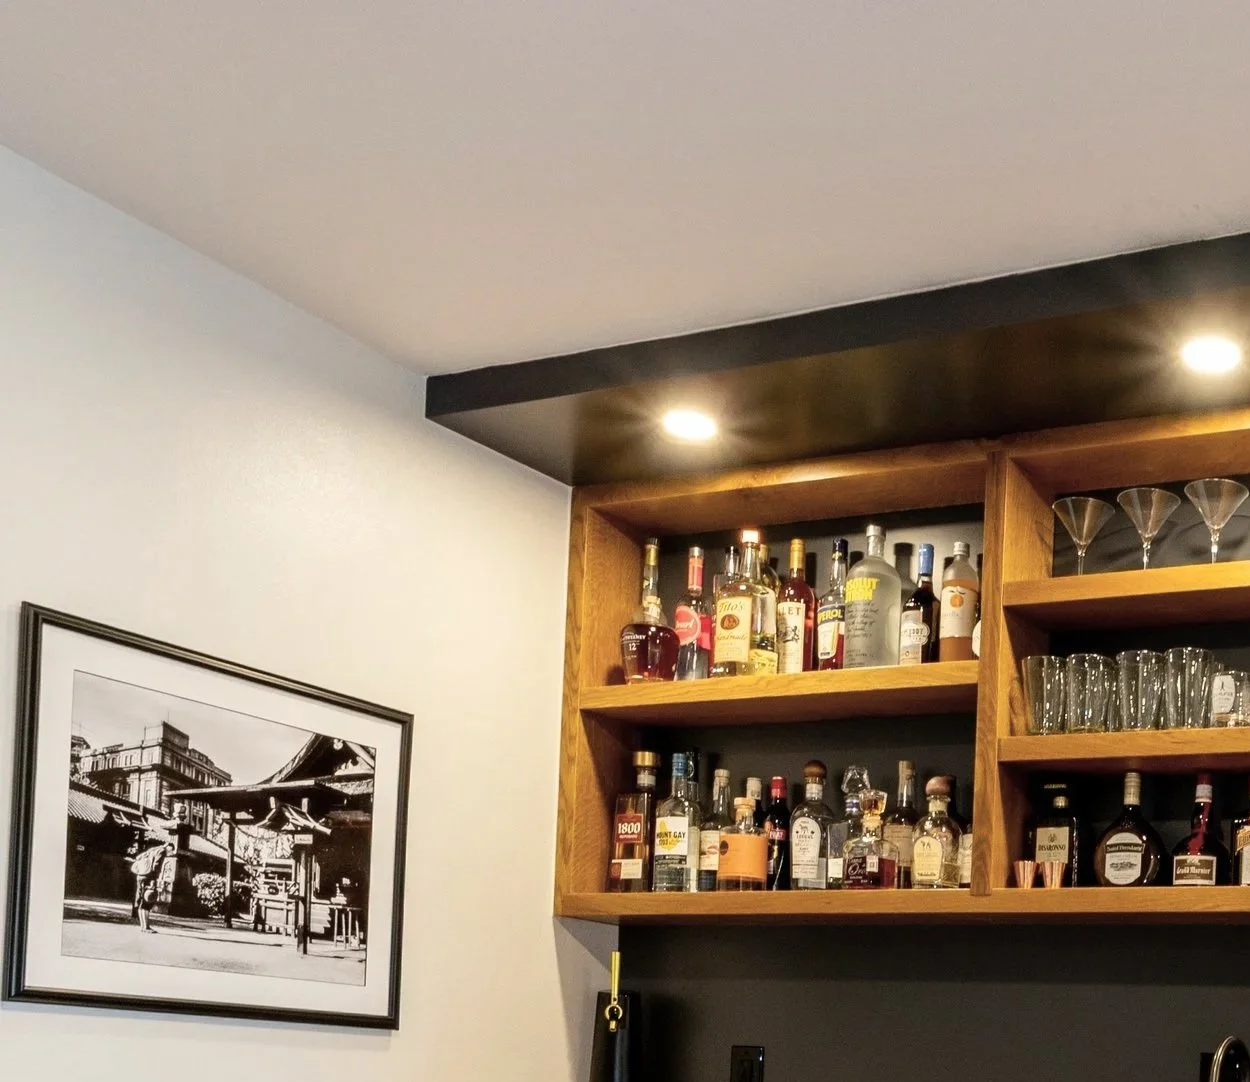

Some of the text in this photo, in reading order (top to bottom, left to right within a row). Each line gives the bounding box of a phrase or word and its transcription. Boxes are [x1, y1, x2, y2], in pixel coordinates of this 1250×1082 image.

[719, 600, 744, 613] Tito's
[617, 822, 641, 834] 1800
[673, 831, 687, 839] GAY
[1037, 844, 1066, 852] DISARONNO
